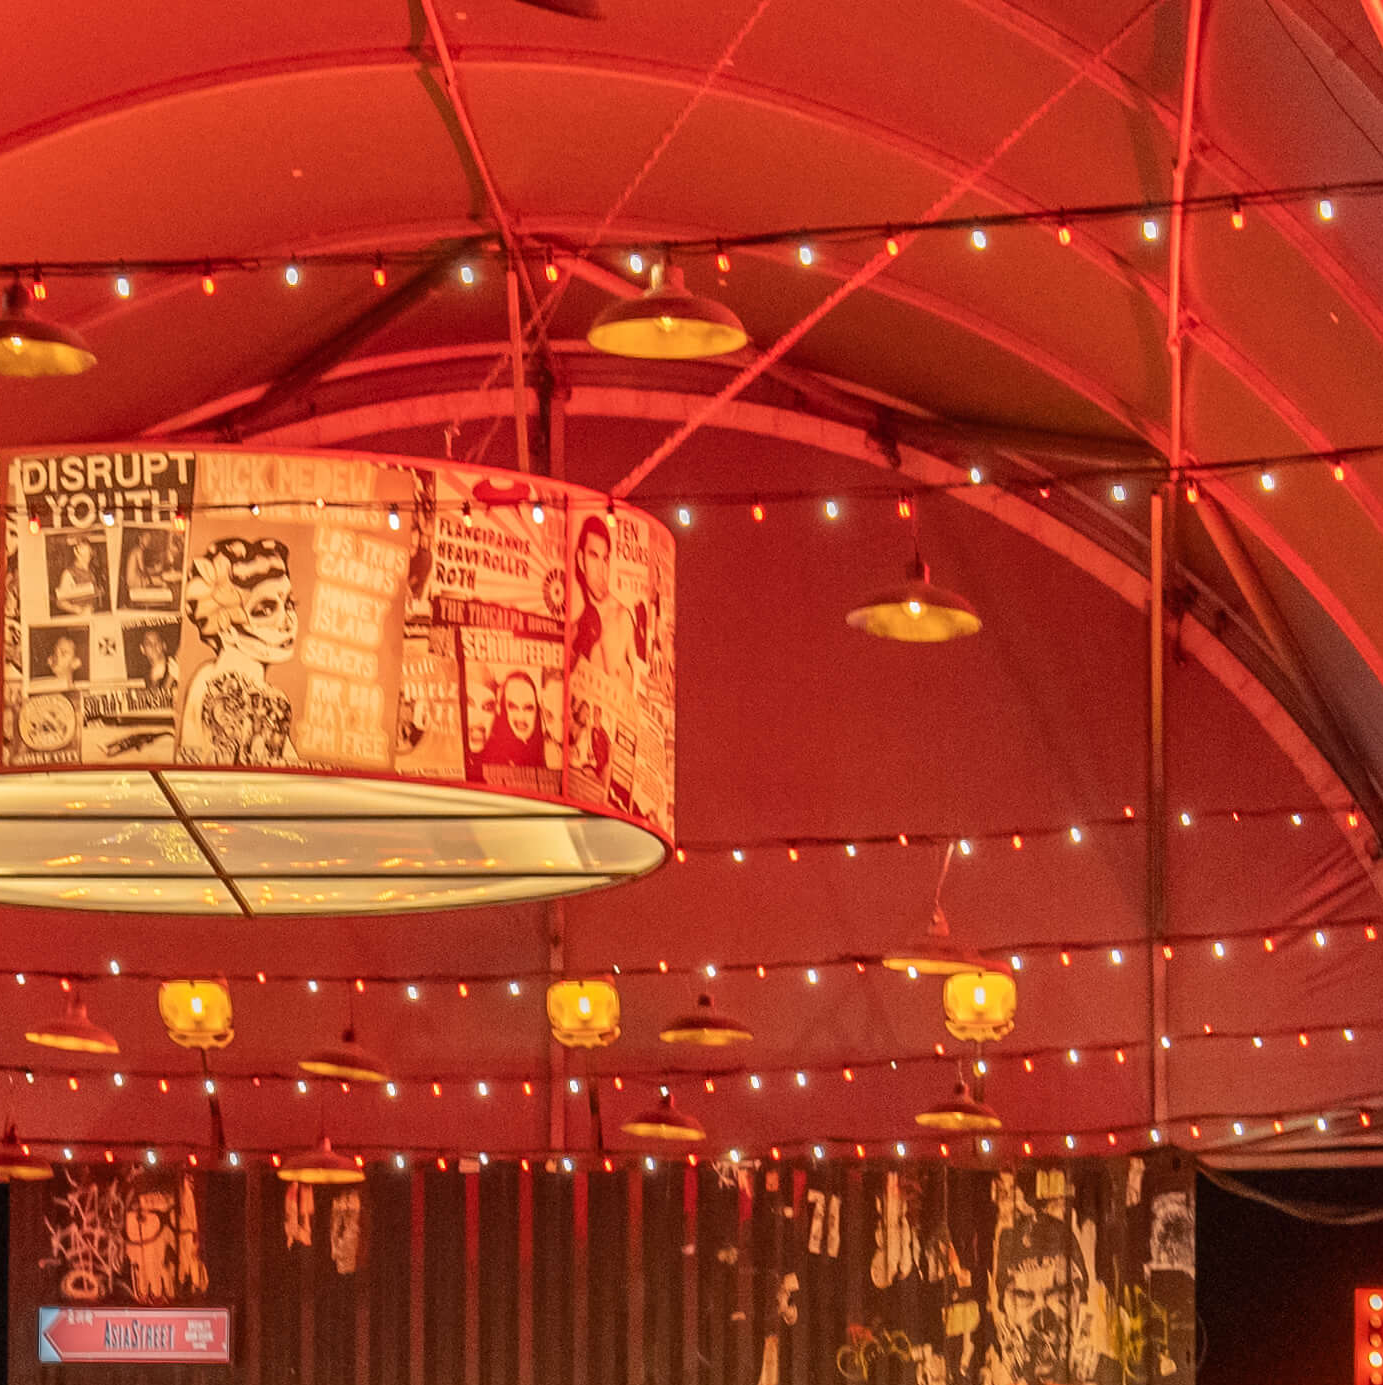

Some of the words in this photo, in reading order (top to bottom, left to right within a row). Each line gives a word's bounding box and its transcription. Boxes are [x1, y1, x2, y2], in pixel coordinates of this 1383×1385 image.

[23, 452, 194, 494] DISRUPT
[45, 489, 178, 529] YOUTH
[317, 527, 352, 556] LOS
[436, 562, 476, 590] ROTH
[482, 549, 530, 580] ROLLER
[305, 638, 373, 677] SEWERS
